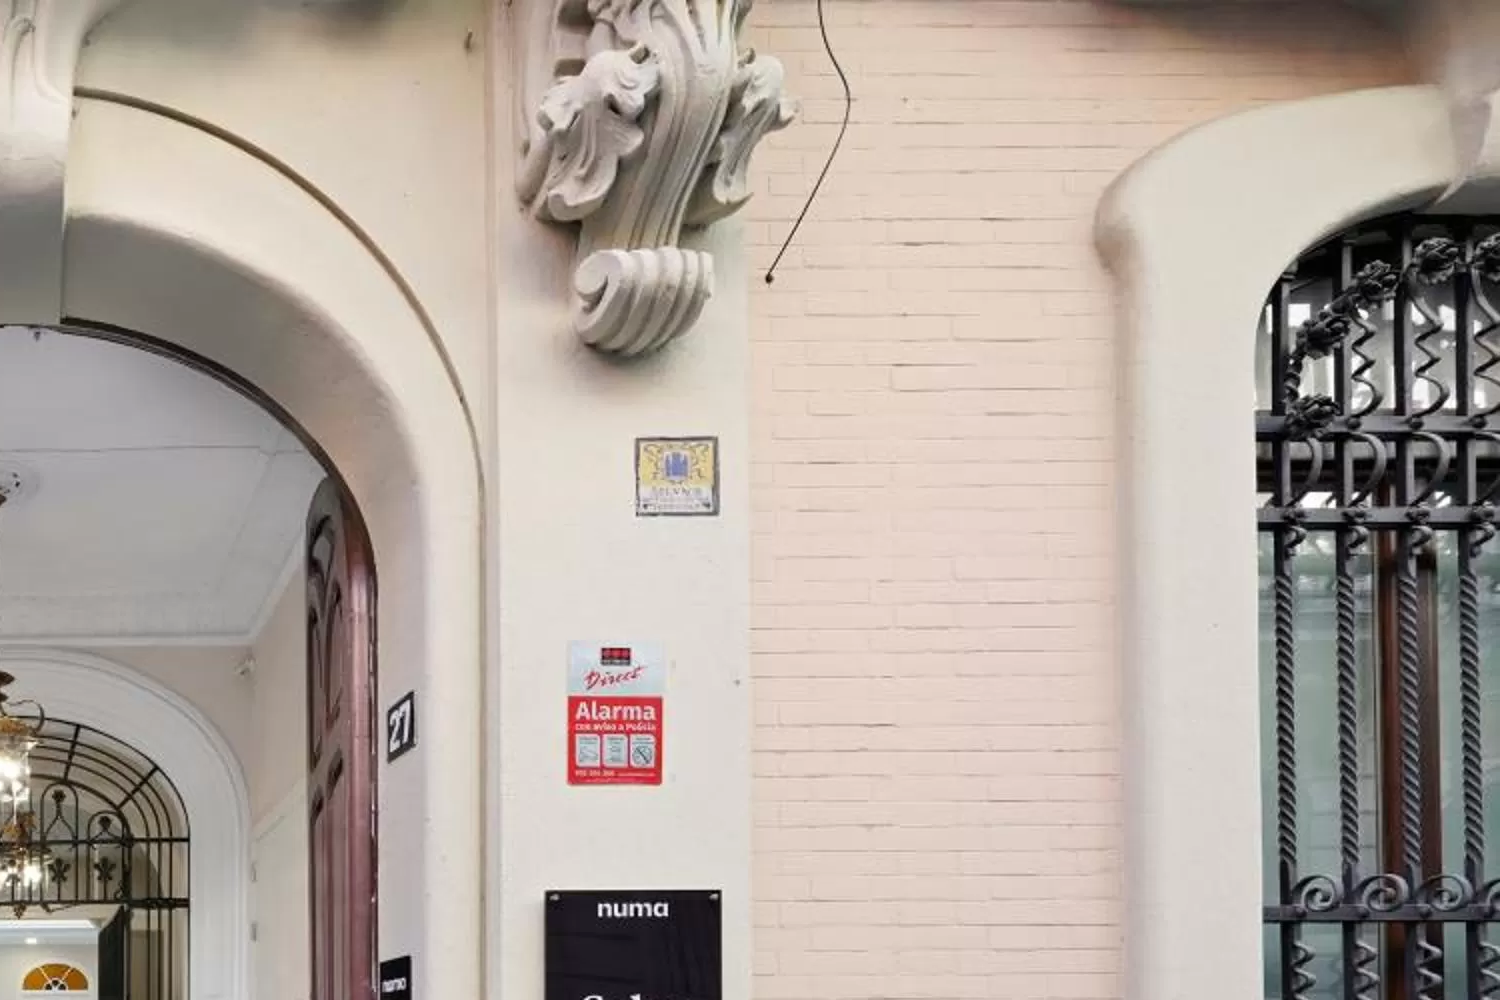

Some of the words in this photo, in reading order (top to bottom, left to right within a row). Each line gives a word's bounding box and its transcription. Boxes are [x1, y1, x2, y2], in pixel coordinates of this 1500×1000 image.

[585, 666, 647, 690] Direct
[575, 700, 656, 721] Alarma
[389, 699, 411, 753] 27
[597, 902, 669, 918] numa
